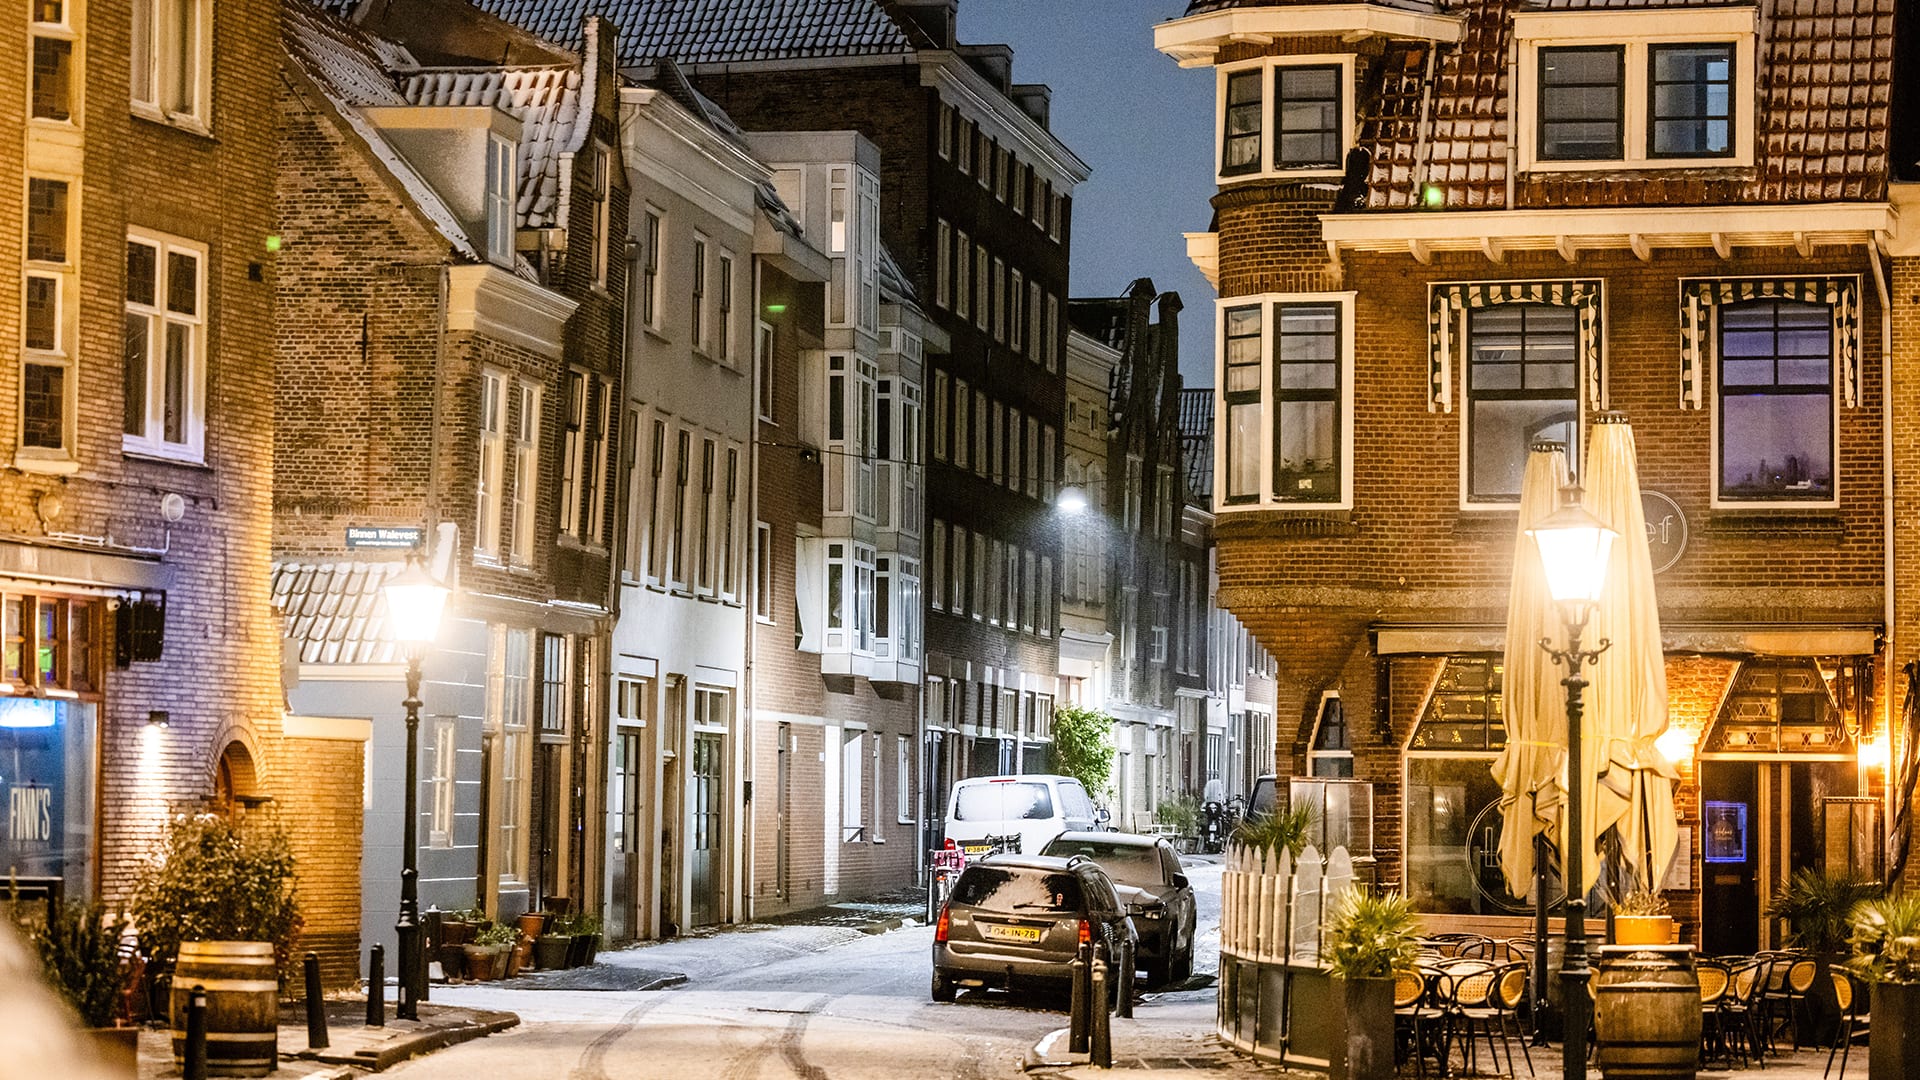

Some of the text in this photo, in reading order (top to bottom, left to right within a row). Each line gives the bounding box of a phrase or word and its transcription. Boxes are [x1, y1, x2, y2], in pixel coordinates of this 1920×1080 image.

[349, 529, 419, 540] Binnen Walevest
[10, 788, 51, 841] FINN'S
